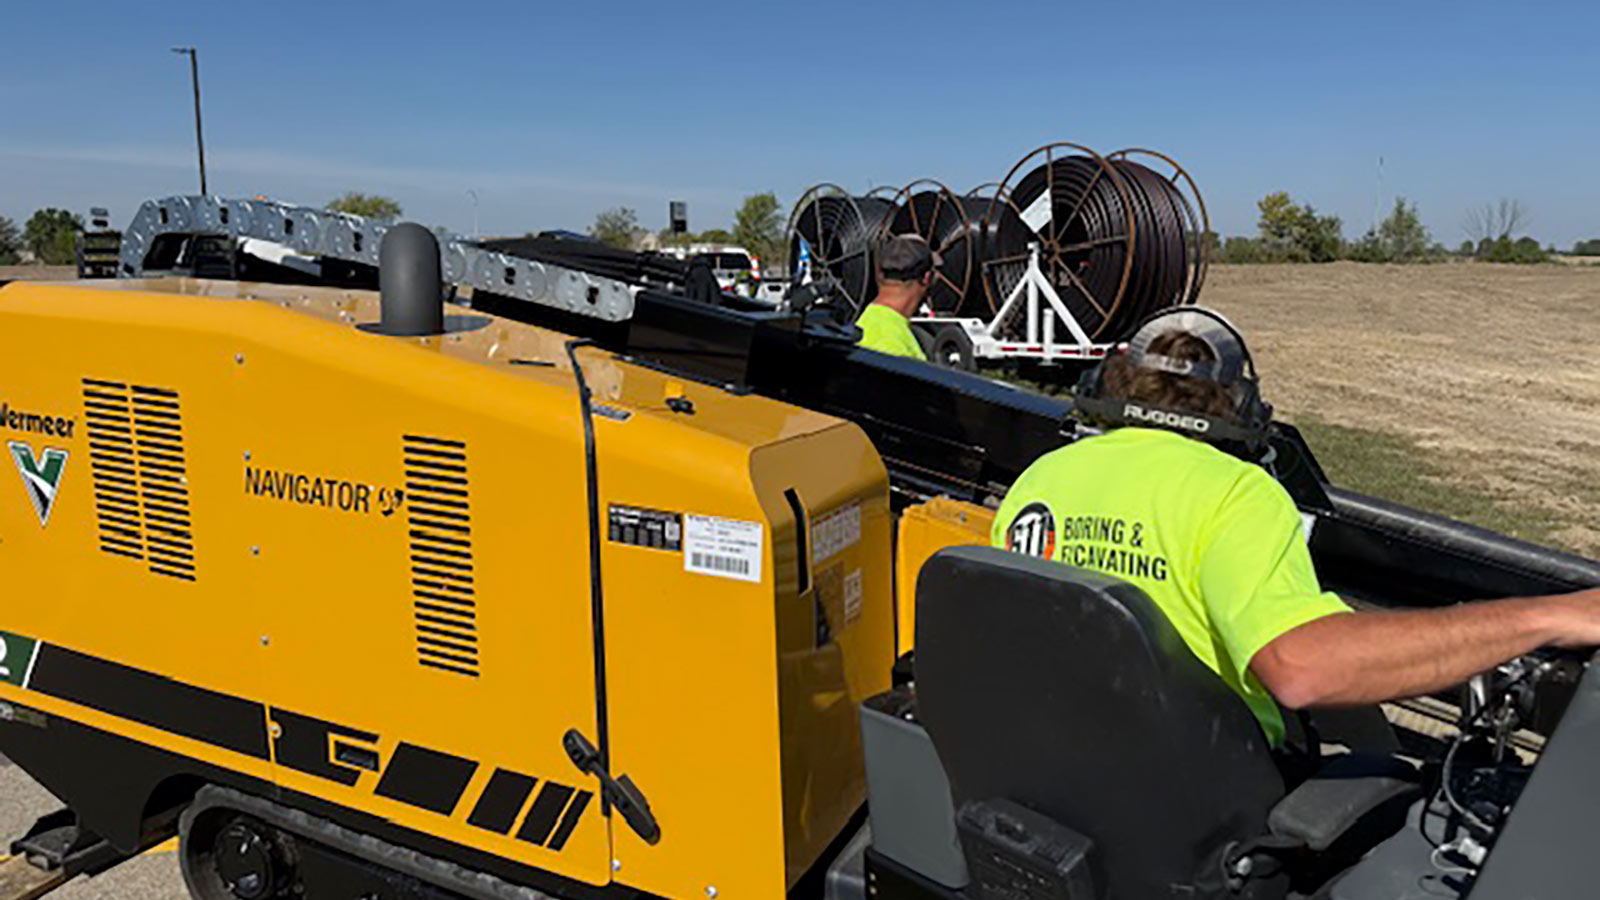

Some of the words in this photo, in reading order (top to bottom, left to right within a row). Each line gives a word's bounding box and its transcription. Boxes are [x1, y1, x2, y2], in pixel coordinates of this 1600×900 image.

[1123, 404, 1209, 432] RUGGED
[244, 466, 370, 513] NAVIGATOR
[1063, 517, 1125, 544] BORING
[1130, 522, 1144, 549] &
